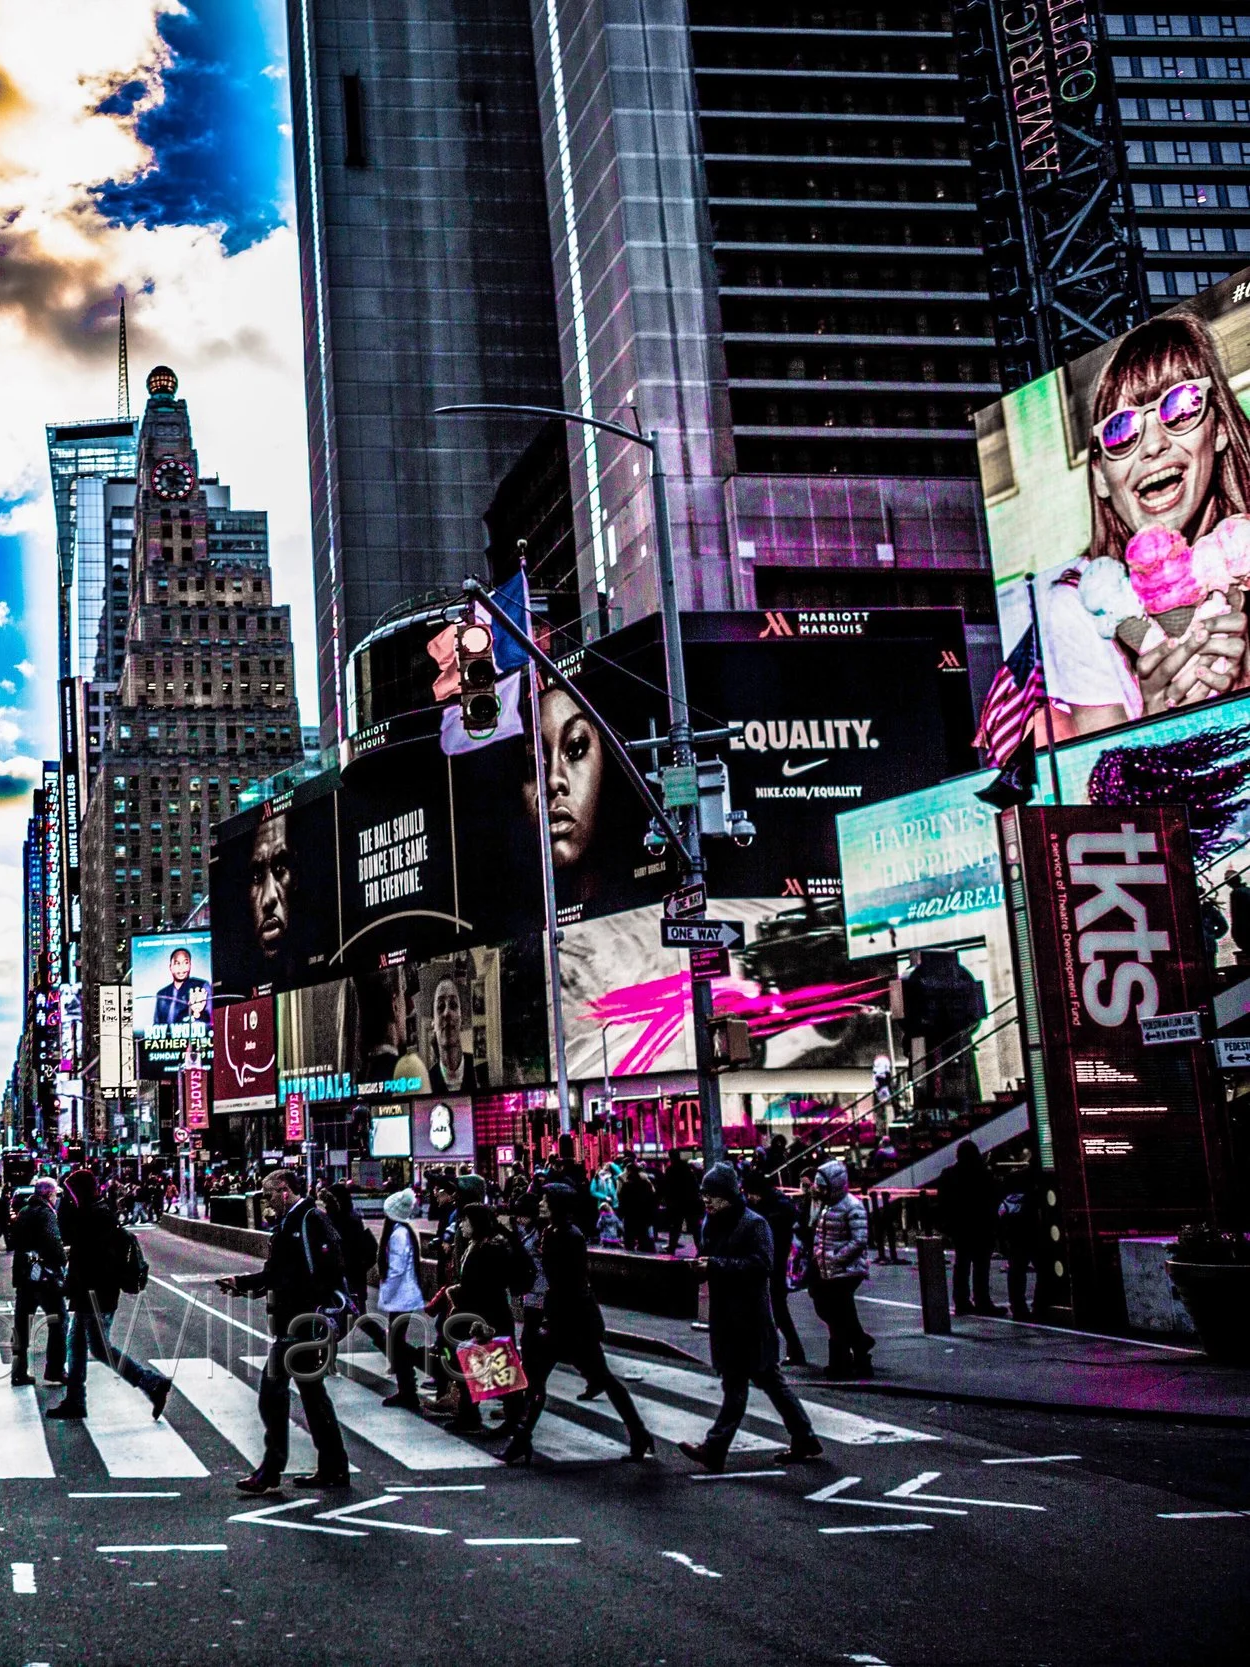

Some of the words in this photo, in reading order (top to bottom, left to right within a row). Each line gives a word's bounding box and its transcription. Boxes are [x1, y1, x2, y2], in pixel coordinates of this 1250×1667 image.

[799, 612, 870, 622] MARRIOTT
[800, 624, 863, 635] MARQUIS
[66, 774, 78, 831] LIMITLESS
[756, 785, 862, 799] NIKE.COM/EQUALITY
[68, 831, 79, 868] IGNITE
[358, 828, 373, 856] THE
[374, 820, 392, 850] BALL
[393, 808, 425, 842] SHOULD
[358, 849, 388, 883] BOUNCE
[389, 844, 404, 870] THE
[405, 835, 429, 866] SAME
[1051, 842, 1062, 878] service
[365, 878, 380, 908] FOR
[381, 867, 424, 903] EVERYONE.
[1056, 880, 1066, 891] of
[1058, 893, 1069, 931] Theatre
[1066, 823, 1171, 1028] tkts
[671, 928, 694, 940] ONE
[697, 928, 720, 940] WAY
[1062, 933, 1078, 998] Development
[1072, 1002, 1082, 1027] Fund
[144, 1039, 187, 1050] FATHER
[149, 1051, 180, 1061] SUNDAY
[191, 1070, 202, 1108] LOVE
[290, 1094, 299, 1124] LOVE
